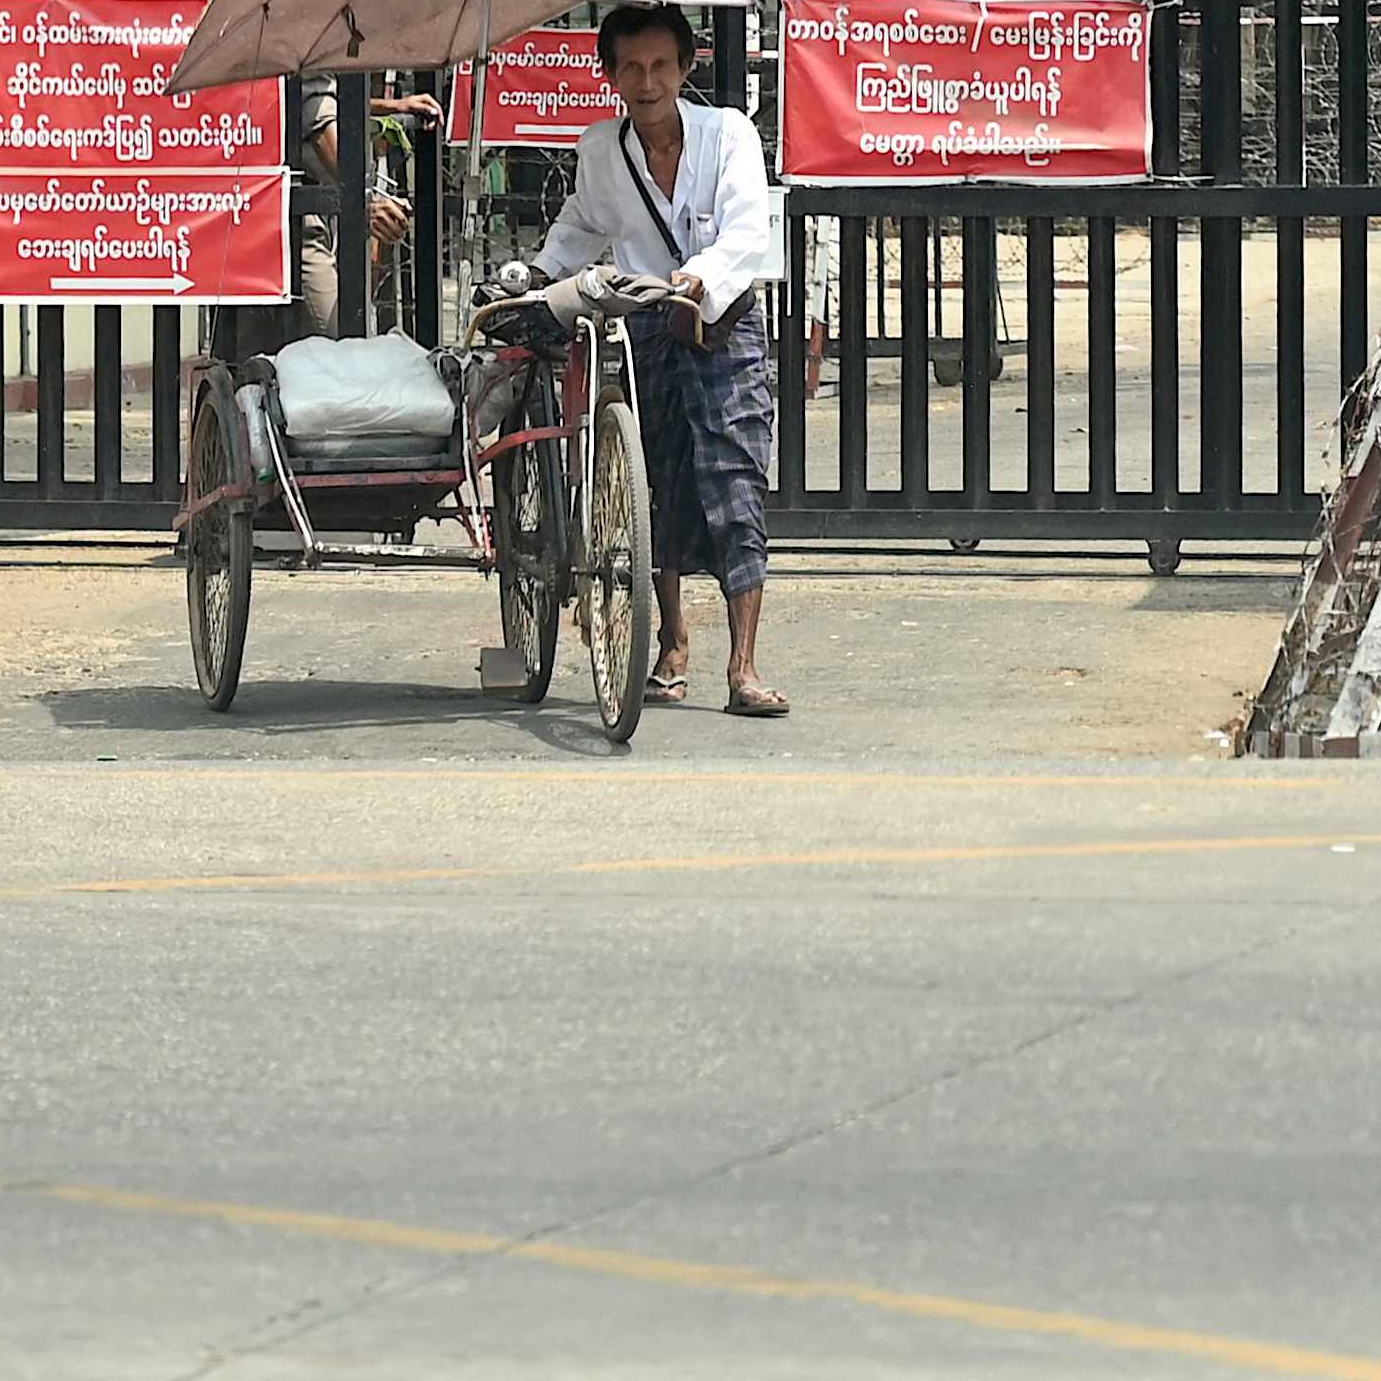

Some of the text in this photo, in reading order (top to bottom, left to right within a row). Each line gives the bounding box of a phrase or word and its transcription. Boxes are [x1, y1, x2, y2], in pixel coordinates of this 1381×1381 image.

[990, 11, 1143, 62] မေးမြန်းခြင်းကို
[7, 62, 126, 109] ဆိုင်ကယ်ပေါ်မှ
[159, 113, 262, 160] သတင်းပို့ပါ။
[17, 225, 192, 271] ဘေးချရပ်ပေးပါရန်
